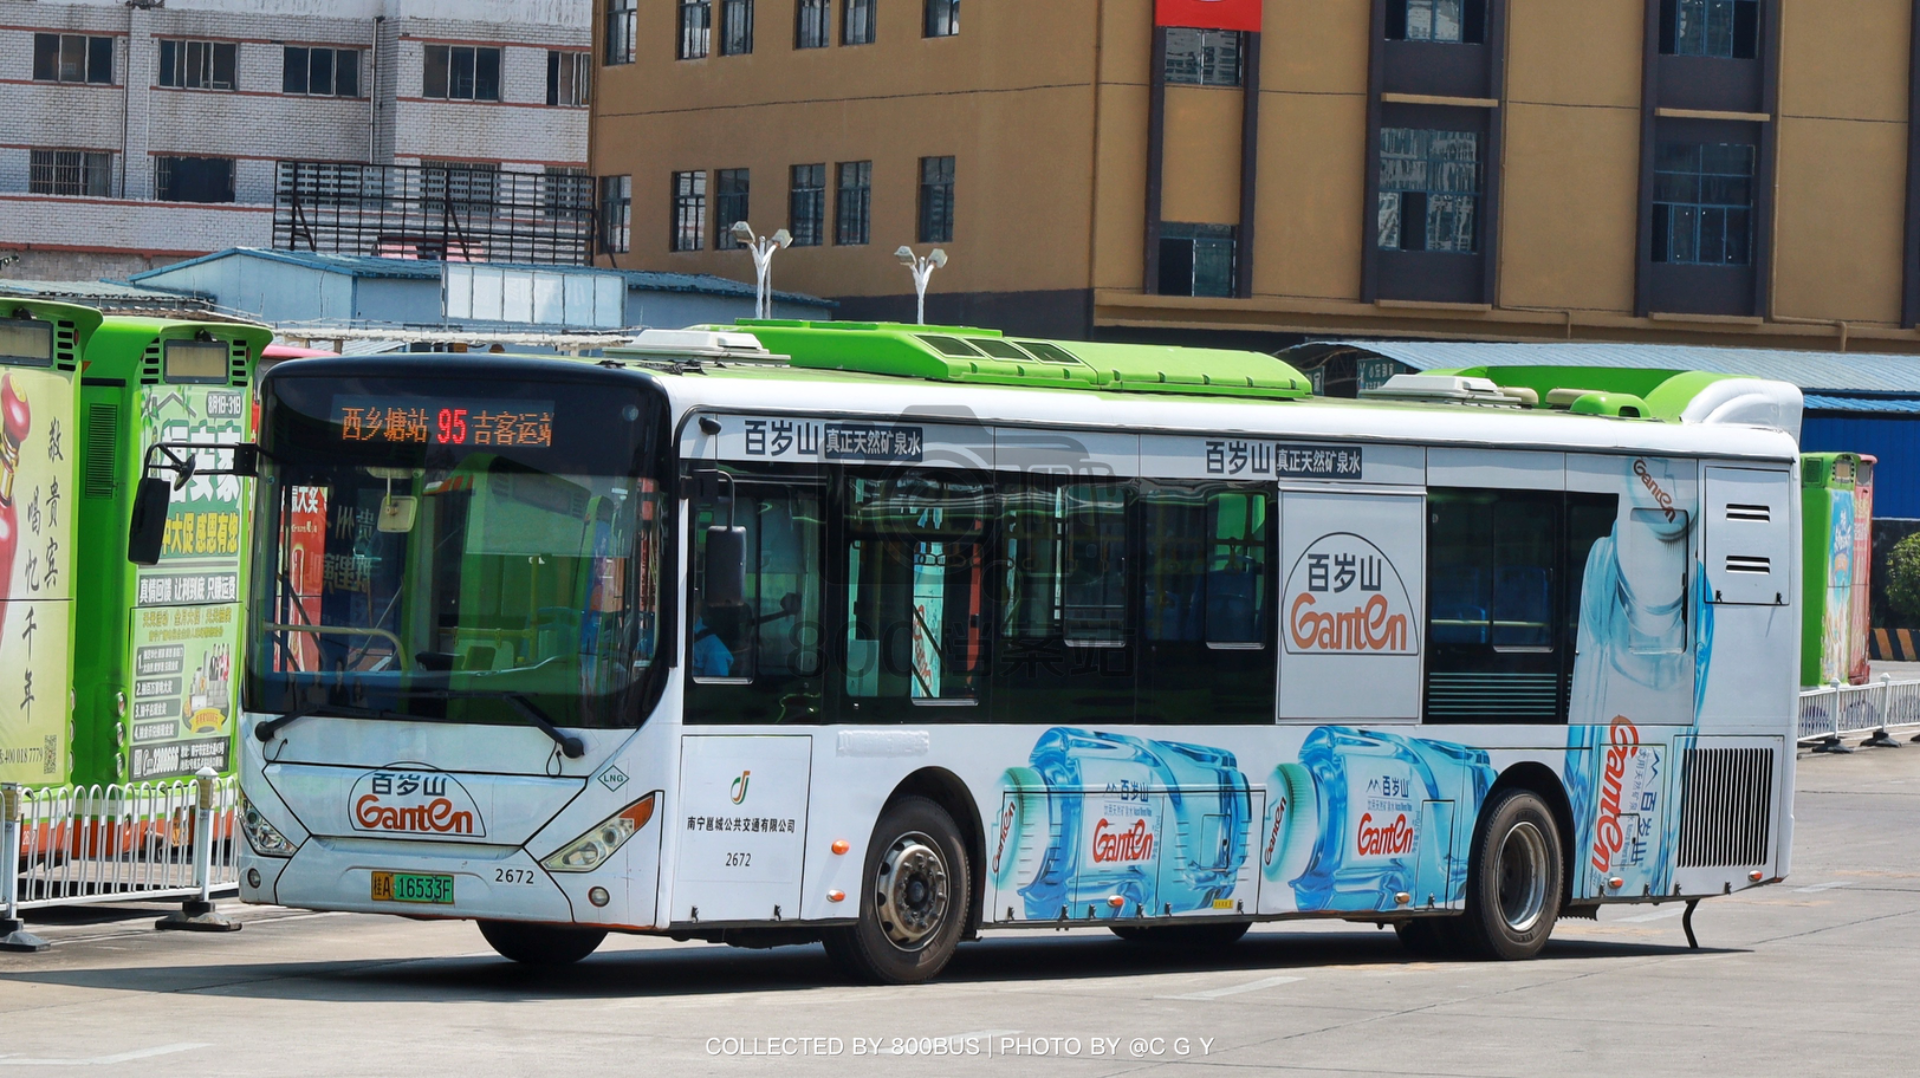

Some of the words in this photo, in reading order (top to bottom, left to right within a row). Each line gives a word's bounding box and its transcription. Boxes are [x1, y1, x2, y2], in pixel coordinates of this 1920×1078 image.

[341, 407, 430, 443] 西乡塘站
[437, 408, 468, 444] 95
[745, 420, 819, 457] 百岁山
[825, 428, 922, 457] 真正天然矿泉水
[1206, 441, 1271, 475] 百岁山
[1276, 448, 1361, 474] 真正天然矿泉水
[1307, 552, 1382, 594] 百岁山
[1290, 592, 1408, 651] Ganten
[372, 772, 448, 797] 百岁山
[603, 773, 624, 783] LNG
[1120, 779, 1149, 803] 百岁山
[1382, 775, 1409, 798] 百岁山
[356, 794, 473, 834] Ganten
[687, 816, 796, 834] 南宁邕城公共交通有限公司
[1630, 792, 1658, 863] 百岁山
[1092, 818, 1153, 863] Ganten
[1357, 812, 1414, 856] Ganten
[495, 868, 534, 885] 2672
[725, 852, 752, 867] 2672
[399, 877, 452, 900] 16533F
